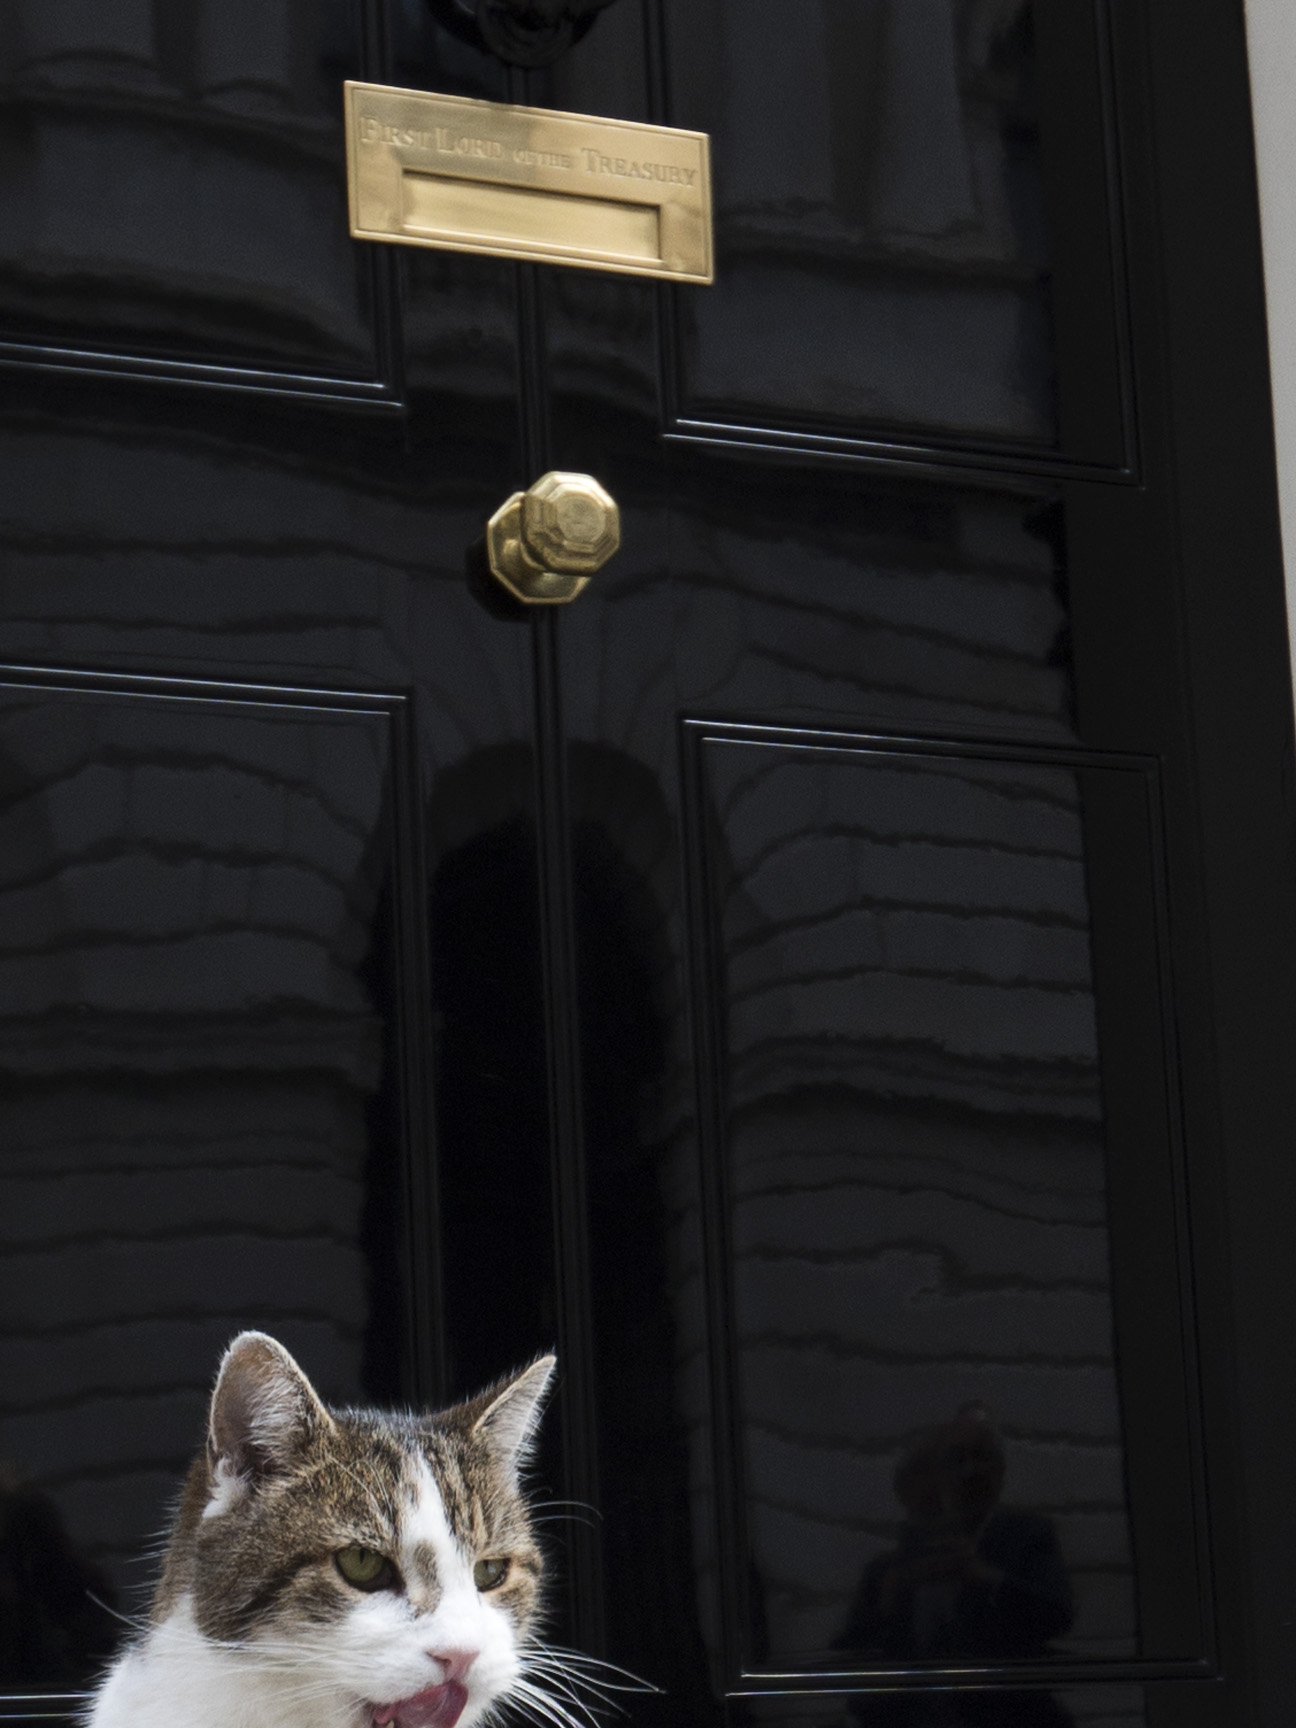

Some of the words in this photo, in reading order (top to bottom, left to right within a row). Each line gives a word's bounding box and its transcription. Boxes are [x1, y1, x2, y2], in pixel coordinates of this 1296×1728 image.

[360, 116, 431, 149] FIRST
[437, 127, 503, 161] LORD
[582, 147, 698, 187] TREASURY
